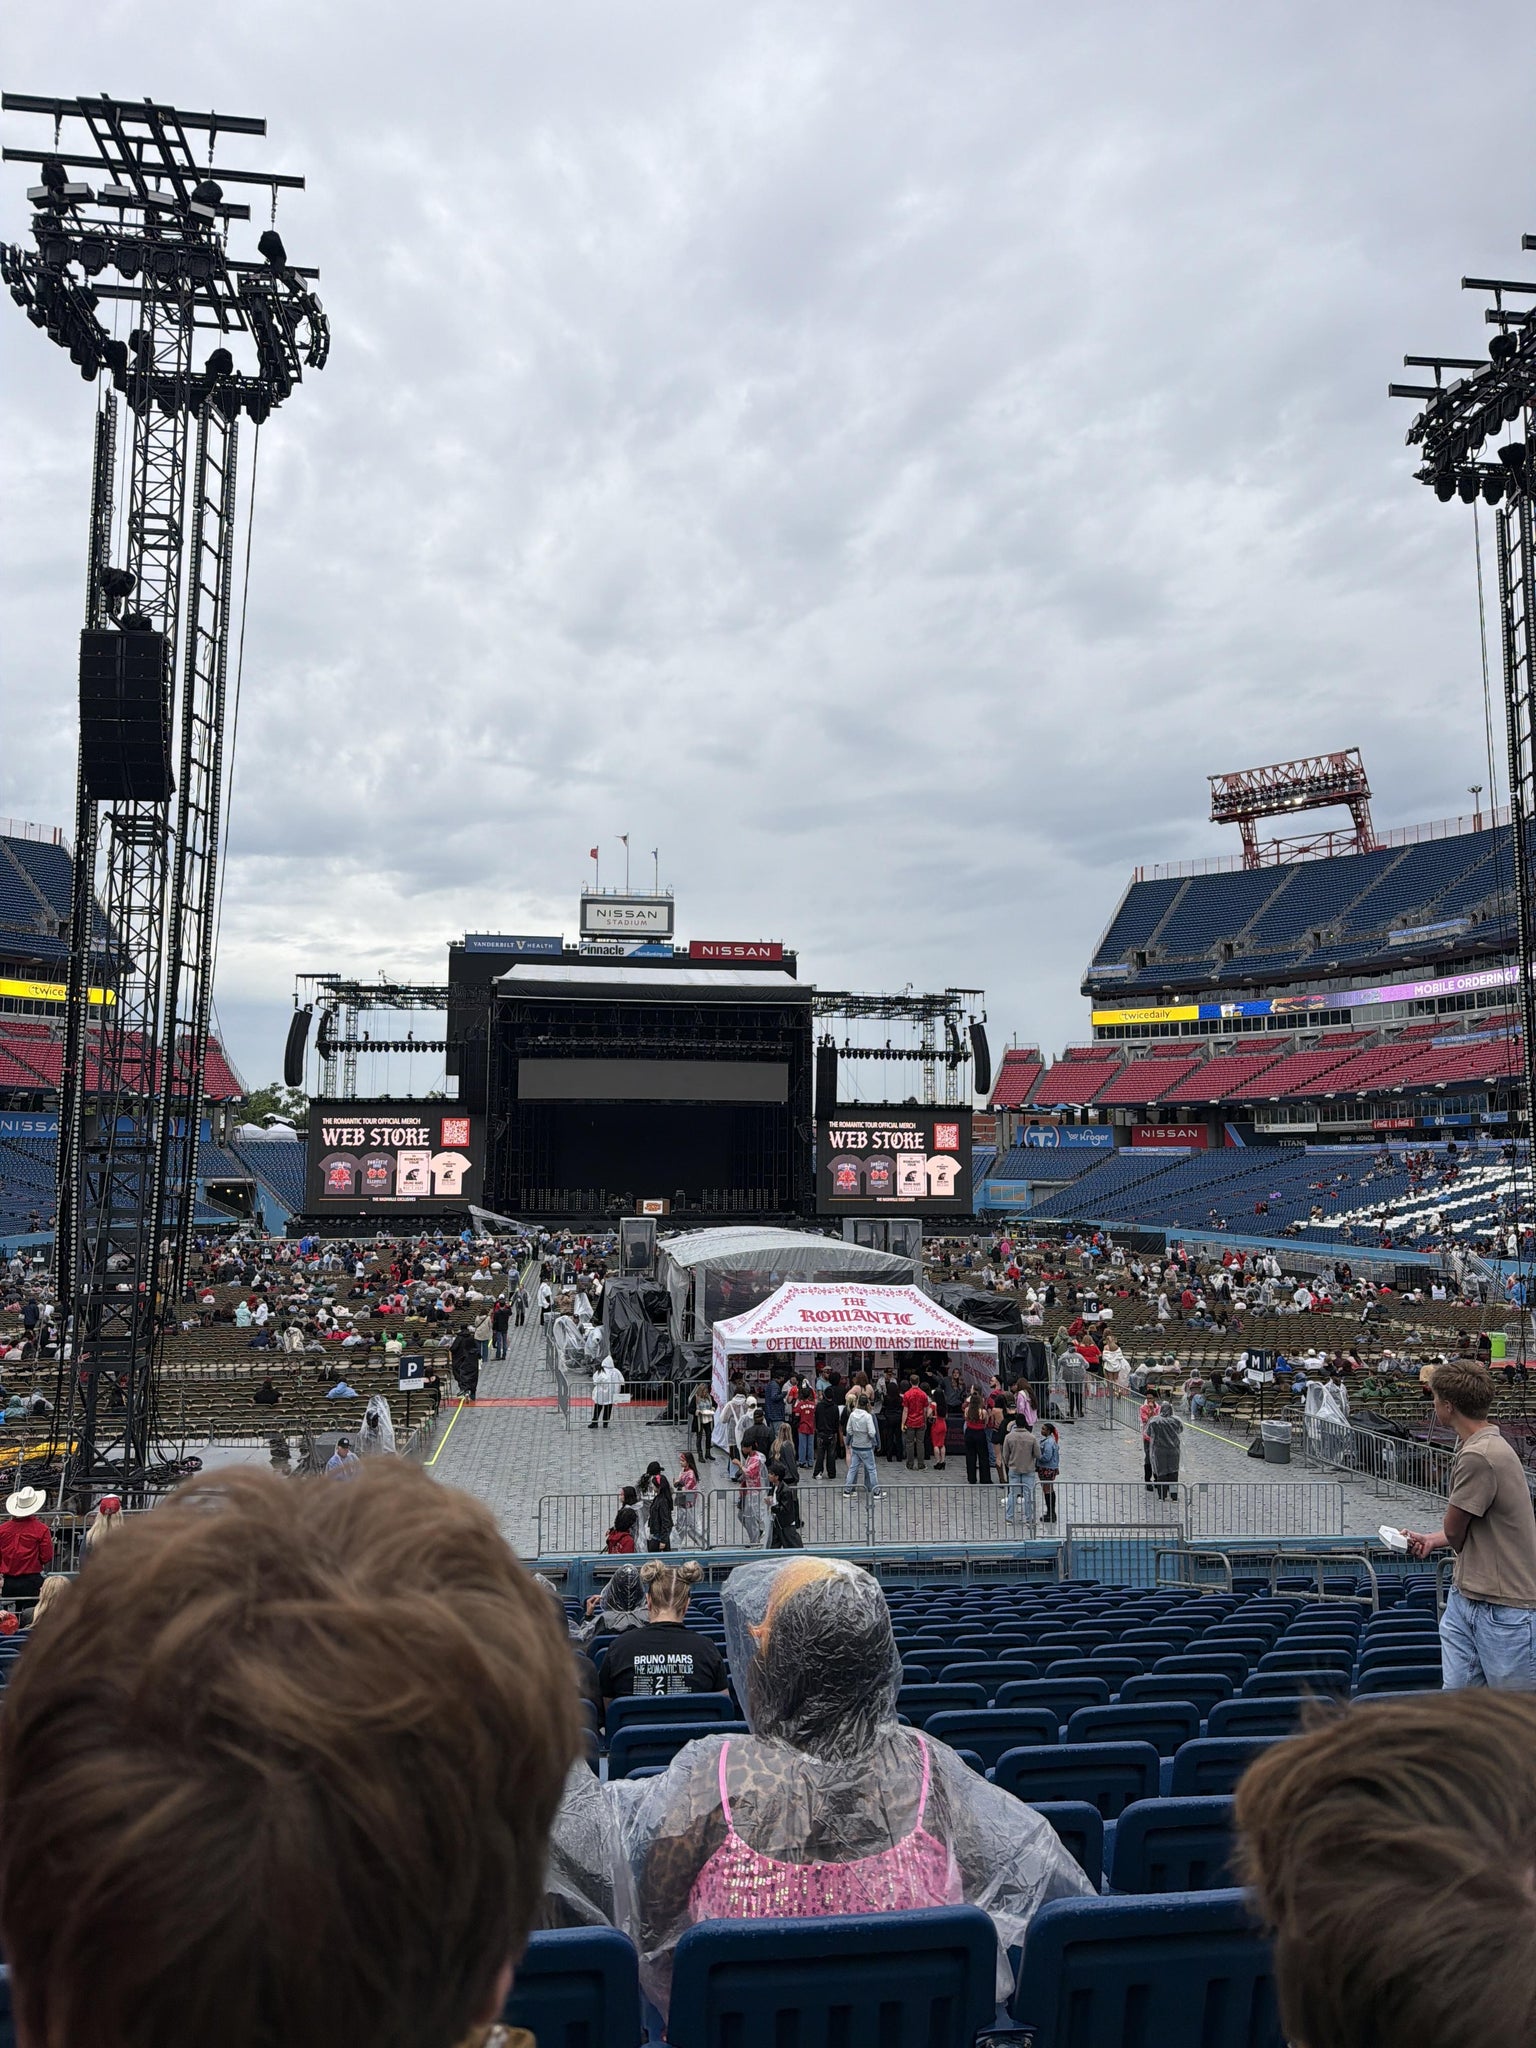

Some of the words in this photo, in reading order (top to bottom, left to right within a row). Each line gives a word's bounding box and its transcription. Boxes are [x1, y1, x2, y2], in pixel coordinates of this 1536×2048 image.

[597, 908, 657, 919] NISSAN
[606, 918, 648, 926] STADIUM
[473, 941, 515, 949] VANDERBILT
[580, 943, 625, 955] Pinnacle
[702, 945, 770, 957] NISSAN
[1414, 980, 1455, 996] MOBILE
[1457, 971, 1513, 989] ORDERING
[1122, 1010, 1170, 1020] twicedaily
[0, 1120, 59, 1132] NISSA
[322, 1117, 332, 1125] THE
[333, 1117, 362, 1125] ROMANTIC
[362, 1117, 377, 1125] TOUR
[377, 1117, 400, 1125] OFFICIAL
[401, 1117, 421, 1125] MERCH
[321, 1127, 366, 1146] WEB
[369, 1127, 430, 1146] STORE
[1080, 1129, 1109, 1146] Kroger
[1141, 1129, 1198, 1138] NISSAN
[829, 1130, 869, 1149] WEB
[871, 1131, 925, 1150] STORE
[1278, 1139, 1308, 1147] TITANS
[567, 1275, 574, 1284] H
[841, 1297, 867, 1307] THE
[1090, 1302, 1097, 1312] G
[798, 1308, 916, 1326] ROMANTIC
[766, 1336, 827, 1351] OFFICIAL
[829, 1336, 873, 1350] BRUNO
[875, 1336, 911, 1349] MARS
[913, 1336, 960, 1350] MERCH
[1251, 1354, 1260, 1370] M
[407, 1362, 418, 1377] P
[634, 1654, 666, 1665] BRUNO
[667, 1654, 693, 1664] MARS
[634, 1664, 646, 1674] THE
[646, 1664, 677, 1674] ROMANTIC
[678, 1664, 694, 1674] TOUR
[655, 1676, 665, 1689] 2
